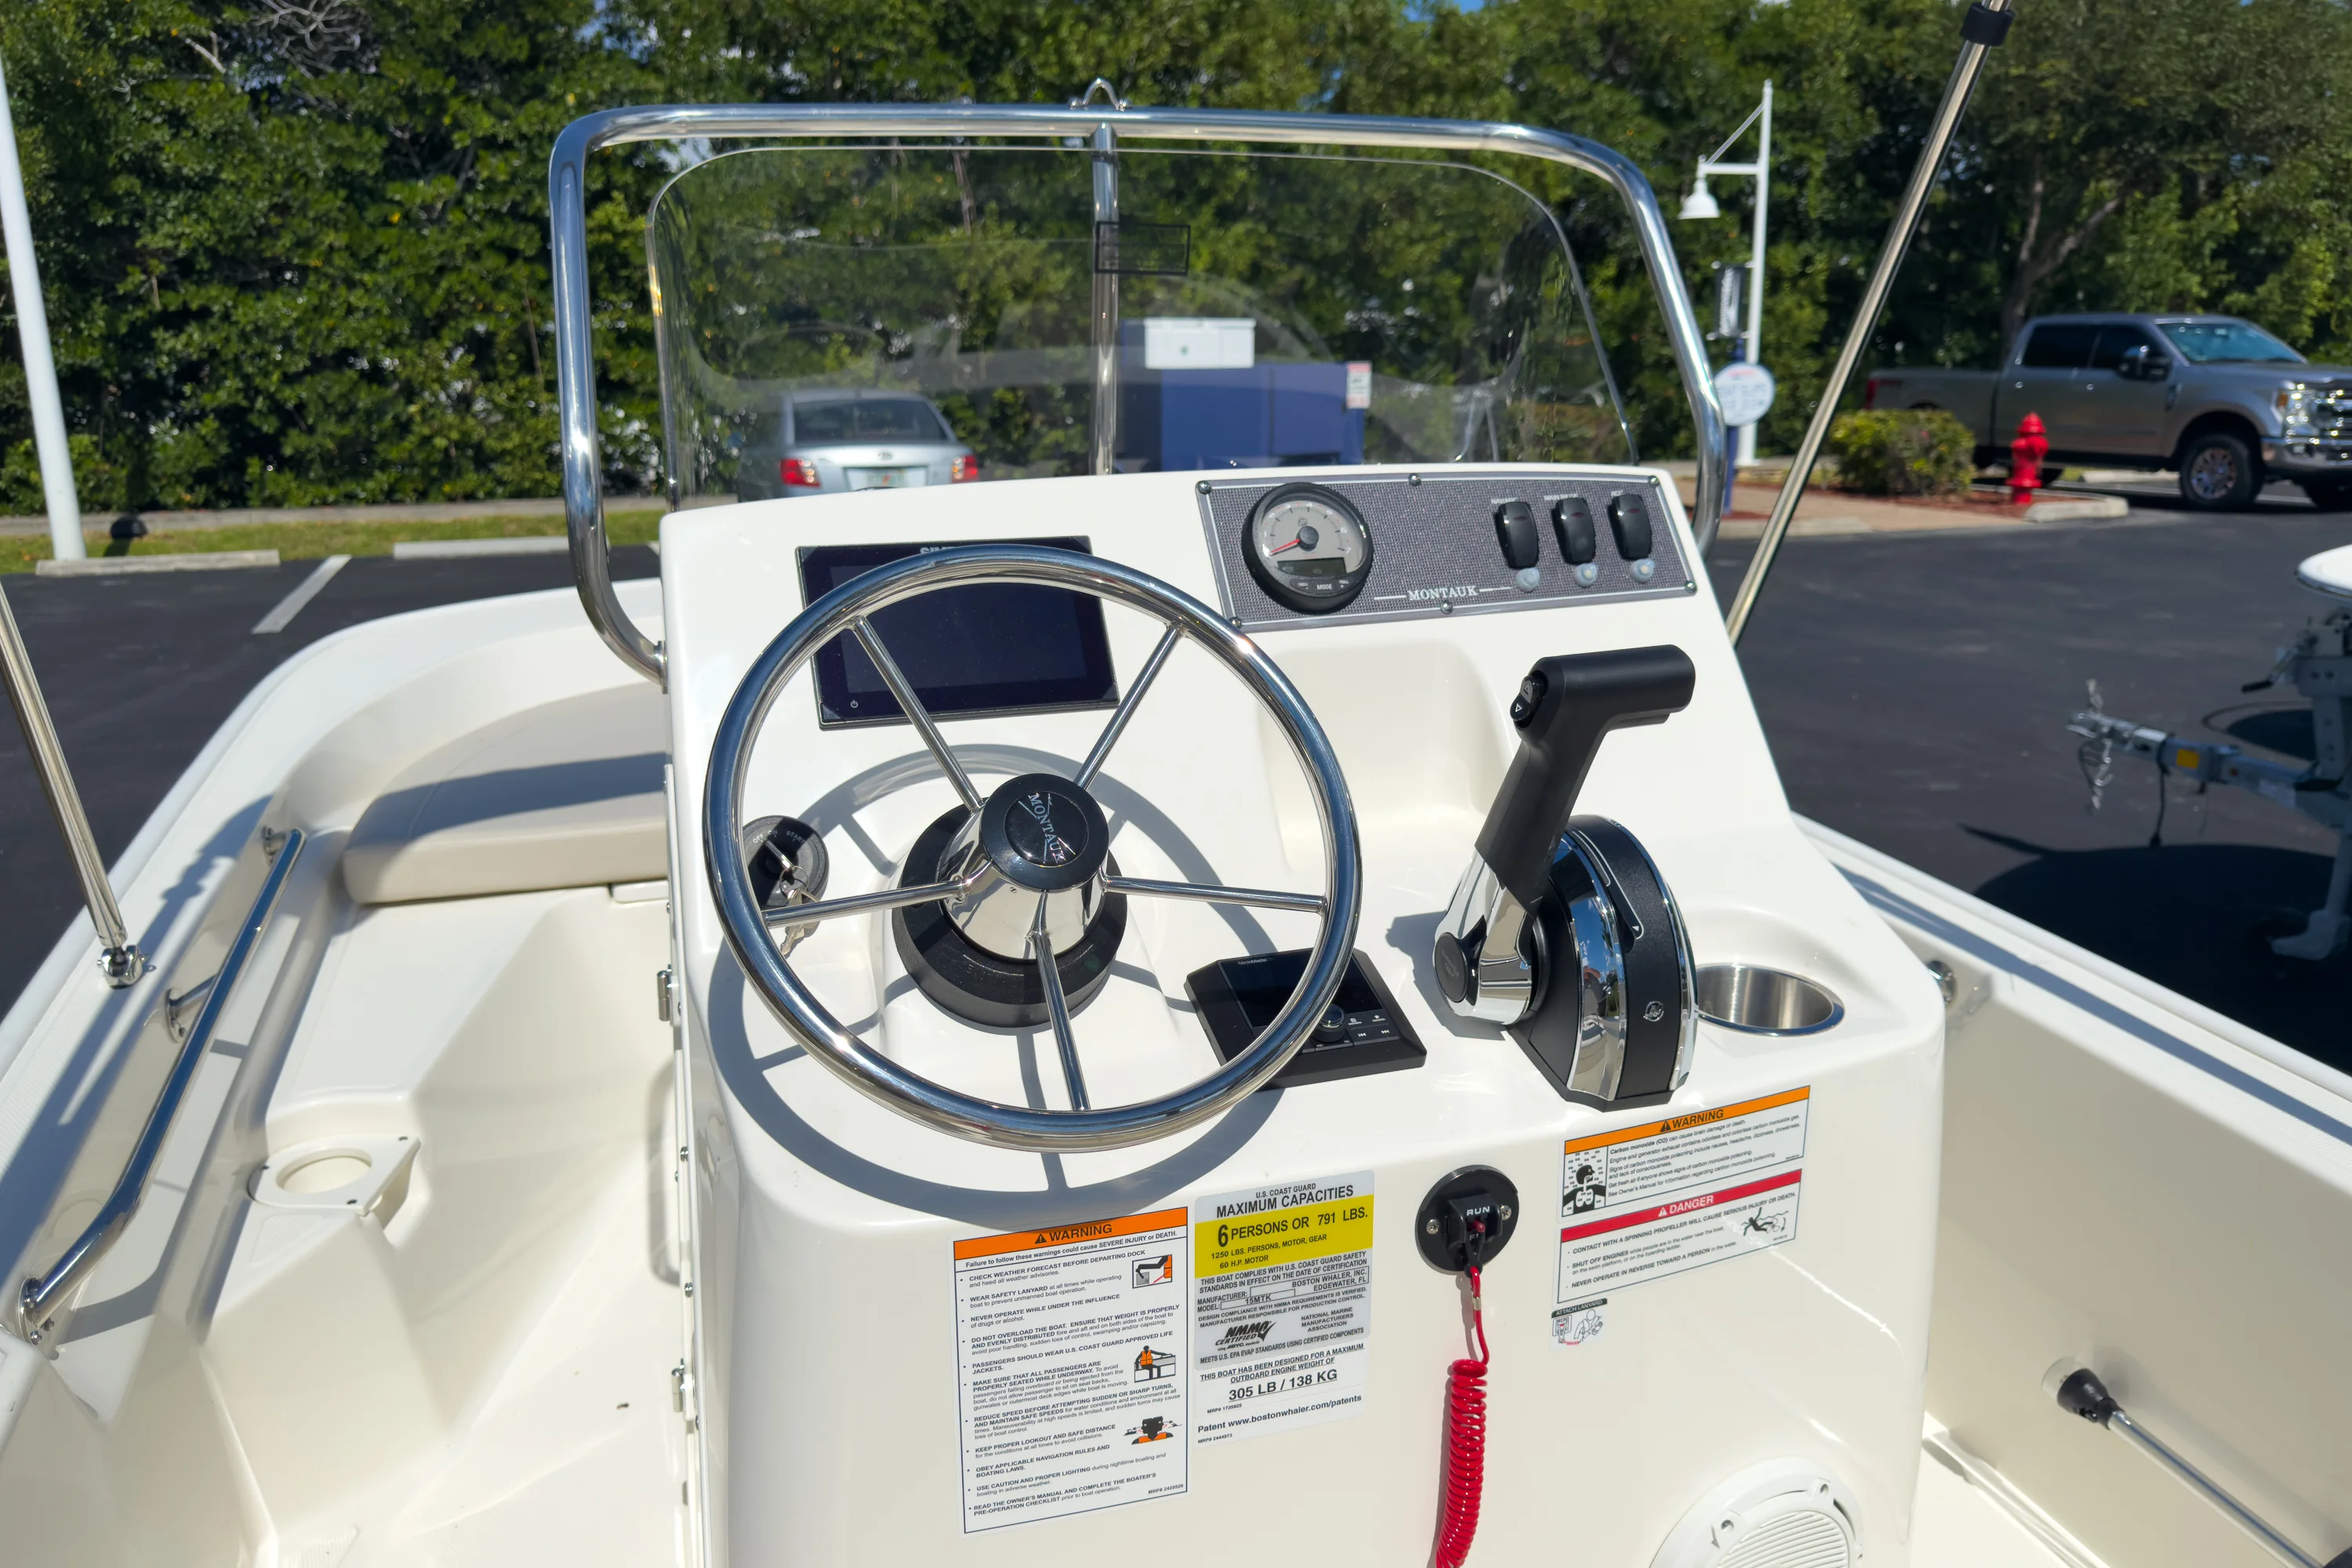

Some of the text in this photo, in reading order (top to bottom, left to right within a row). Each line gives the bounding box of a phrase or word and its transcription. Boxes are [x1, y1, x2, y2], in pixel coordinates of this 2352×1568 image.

[1407, 586, 1478, 601] MONTAUK
[768, 829, 778, 837] ON
[786, 830, 806, 844] START
[1028, 793, 1067, 864] MONTAUK
[753, 833, 764, 844] OFF
[1672, 1109, 1724, 1127] WARNING
[1630, 1141, 1655, 1149] monoxide
[1269, 1186, 1292, 1196] COAST
[1293, 1182, 1316, 1192] GUARD
[1217, 1185, 1353, 1217] MAXIMUM CAPACITIES
[1669, 1195, 1715, 1213] DANGER
[1466, 1205, 1490, 1217] RUN
[1048, 1224, 1112, 1240] WARNING
[1218, 1207, 1368, 1247] 6 PERSONS OR 791 LBS.
[1573, 1242, 1602, 1254] CONTACT
[1602, 1238, 1618, 1247] WITH
[1624, 1230, 1653, 1241] SPINNING
[1653, 1221, 1687, 1233] PROPELLER
[1703, 1211, 1722, 1221] CAUSE
[1723, 1205, 1748, 1215] SERIOUS
[1748, 1200, 1768, 1209] INJURY
[1098, 1239, 1123, 1247] SEVERE
[1124, 1235, 1147, 1243] INJURY
[1155, 1230, 1177, 1239] DEATH.
[1247, 1242, 1281, 1252] PERSONS,
[1282, 1237, 1308, 1247] MOTOR,
[1308, 1233, 1327, 1242] GEAR
[993, 1269, 1025, 1277] WEATHER
[1026, 1262, 1062, 1272] FORECAST
[1062, 1258, 1089, 1267] BEFORE
[1090, 1253, 1126, 1262] DEPARTING
[1216, 1273, 1234, 1283] BOAT
[1235, 1268, 1267, 1279] COMPLIES
[1298, 1258, 1319, 1268] COAST
[1319, 1255, 1342, 1264] GUARD
[1343, 1250, 1367, 1260] SAFETY
[1244, 1254, 1269, 1264] MOTOR
[1200, 1281, 1238, 1293] STANDARDS
[1247, 1275, 1271, 1285] EFFECT
[1295, 1268, 1312, 1276] DATE
[1323, 1258, 1367, 1272] CERTIFICATION
[1313, 1278, 1357, 1290] EDGEWATER,
[1197, 1291, 1247, 1305] MANUFACTURER:
[1292, 1276, 1320, 1287] BOSTON
[1321, 1271, 1352, 1282] WHALER,
[994, 1308, 1025, 1318] OPERATE
[1085, 1294, 1120, 1303] INFLUENCE
[1197, 1294, 1272, 1312] MODEL: 15MTK
[1555, 1299, 1603, 1316] ATTACH LANYARD
[1301, 1306, 1352, 1320] NATIONAL MARINE
[1301, 1312, 1354, 1327] MANUFACTURERS
[1307, 1320, 1347, 1331] ASSOCIATION
[1200, 1355, 1218, 1363] MEETS
[1240, 1348, 1254, 1356] EVAP
[1255, 1342, 1286, 1353] STANDARDS
[1303, 1334, 1329, 1344] CERTIFIED
[1330, 1327, 1364, 1338] COMPONENTS
[1214, 1332, 1258, 1346] CERTIFIED
[1200, 1372, 1216, 1381] THIS
[1218, 1368, 1237, 1377] BOAT
[1238, 1365, 1253, 1374] HAS
[1254, 1361, 1273, 1370] BEEN
[1274, 1354, 1309, 1366] DESIGNED
[1332, 1343, 1364, 1355] MAXIMUM
[1230, 1370, 1269, 1383] OUTBOARD
[1271, 1364, 1297, 1375] ENGINE
[1298, 1359, 1324, 1370] WEIGHT
[1229, 1369, 1338, 1400] 305 LB / 138 KG
[1198, 1396, 1362, 1432] Patent www.bostonwhaler.com/patents
[1021, 1435, 1052, 1444] LOOKOUT
[1085, 1424, 1116, 1433] DISTANCE
